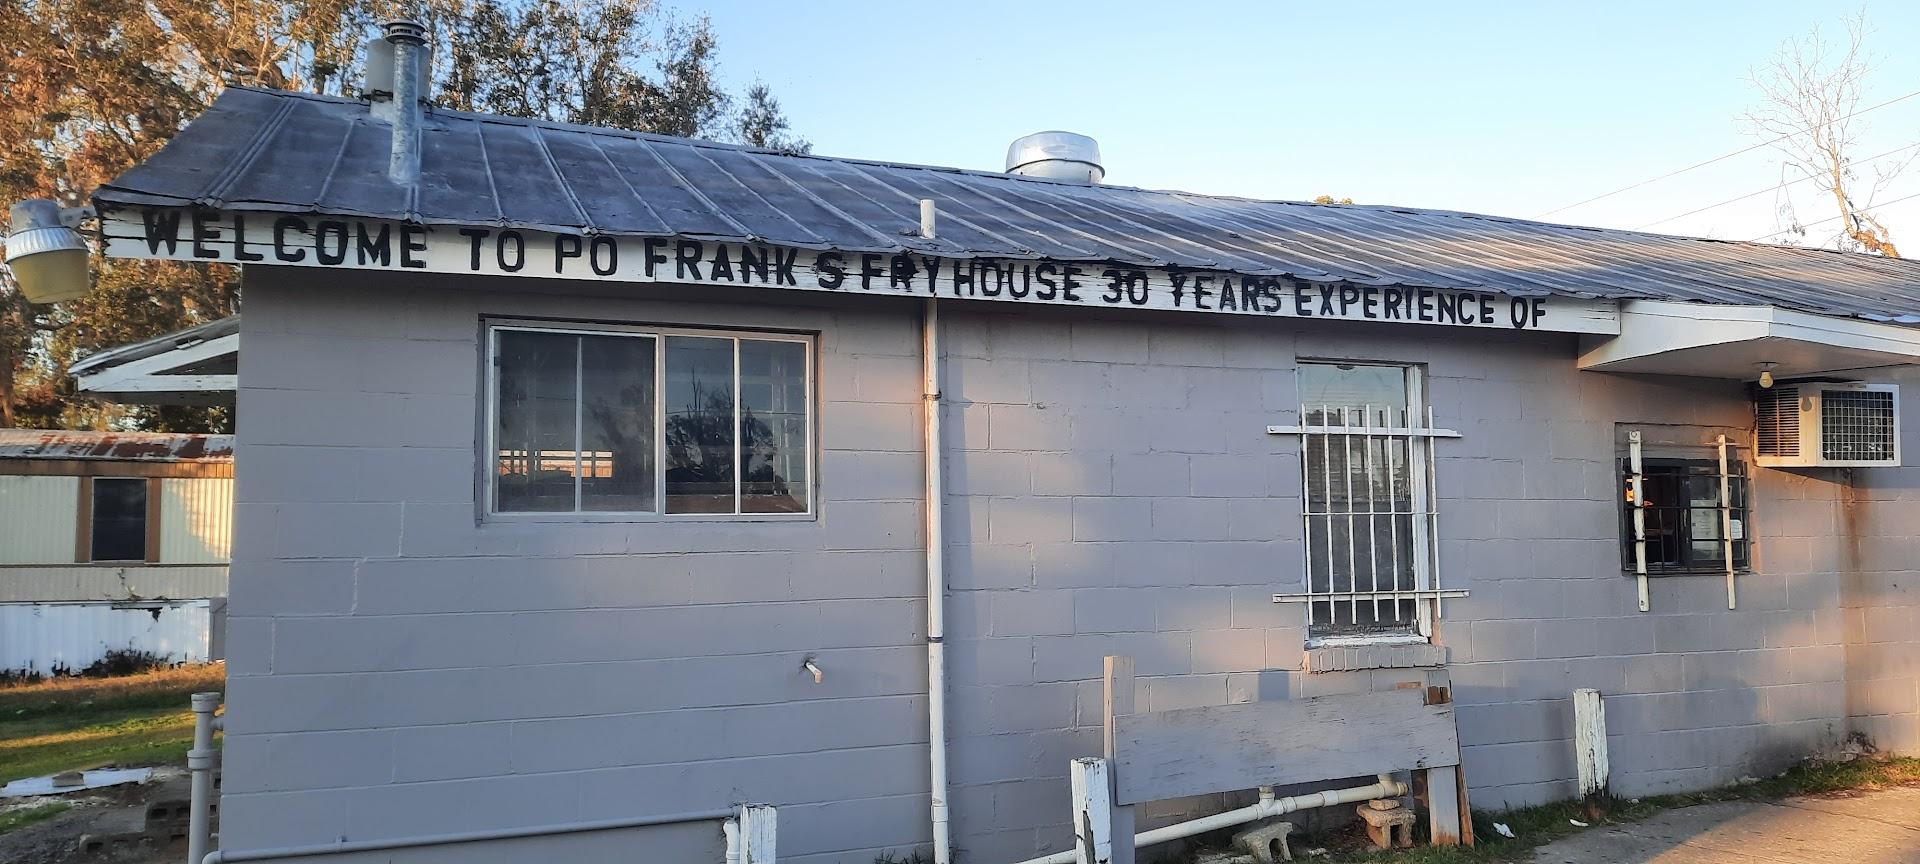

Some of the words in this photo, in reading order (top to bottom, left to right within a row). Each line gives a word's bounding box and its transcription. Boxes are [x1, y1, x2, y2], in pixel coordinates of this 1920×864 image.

[142, 209, 427, 268] WELCOME
[460, 228, 525, 272] TO
[555, 233, 618, 277] PO
[861, 252, 941, 294] FRY
[953, 256, 1082, 301] HOUSE
[1102, 269, 1149, 305] 30
[1168, 272, 1281, 313] YEARS
[1294, 281, 1495, 325] EXPERIENCE
[1510, 296, 1547, 329] OF
